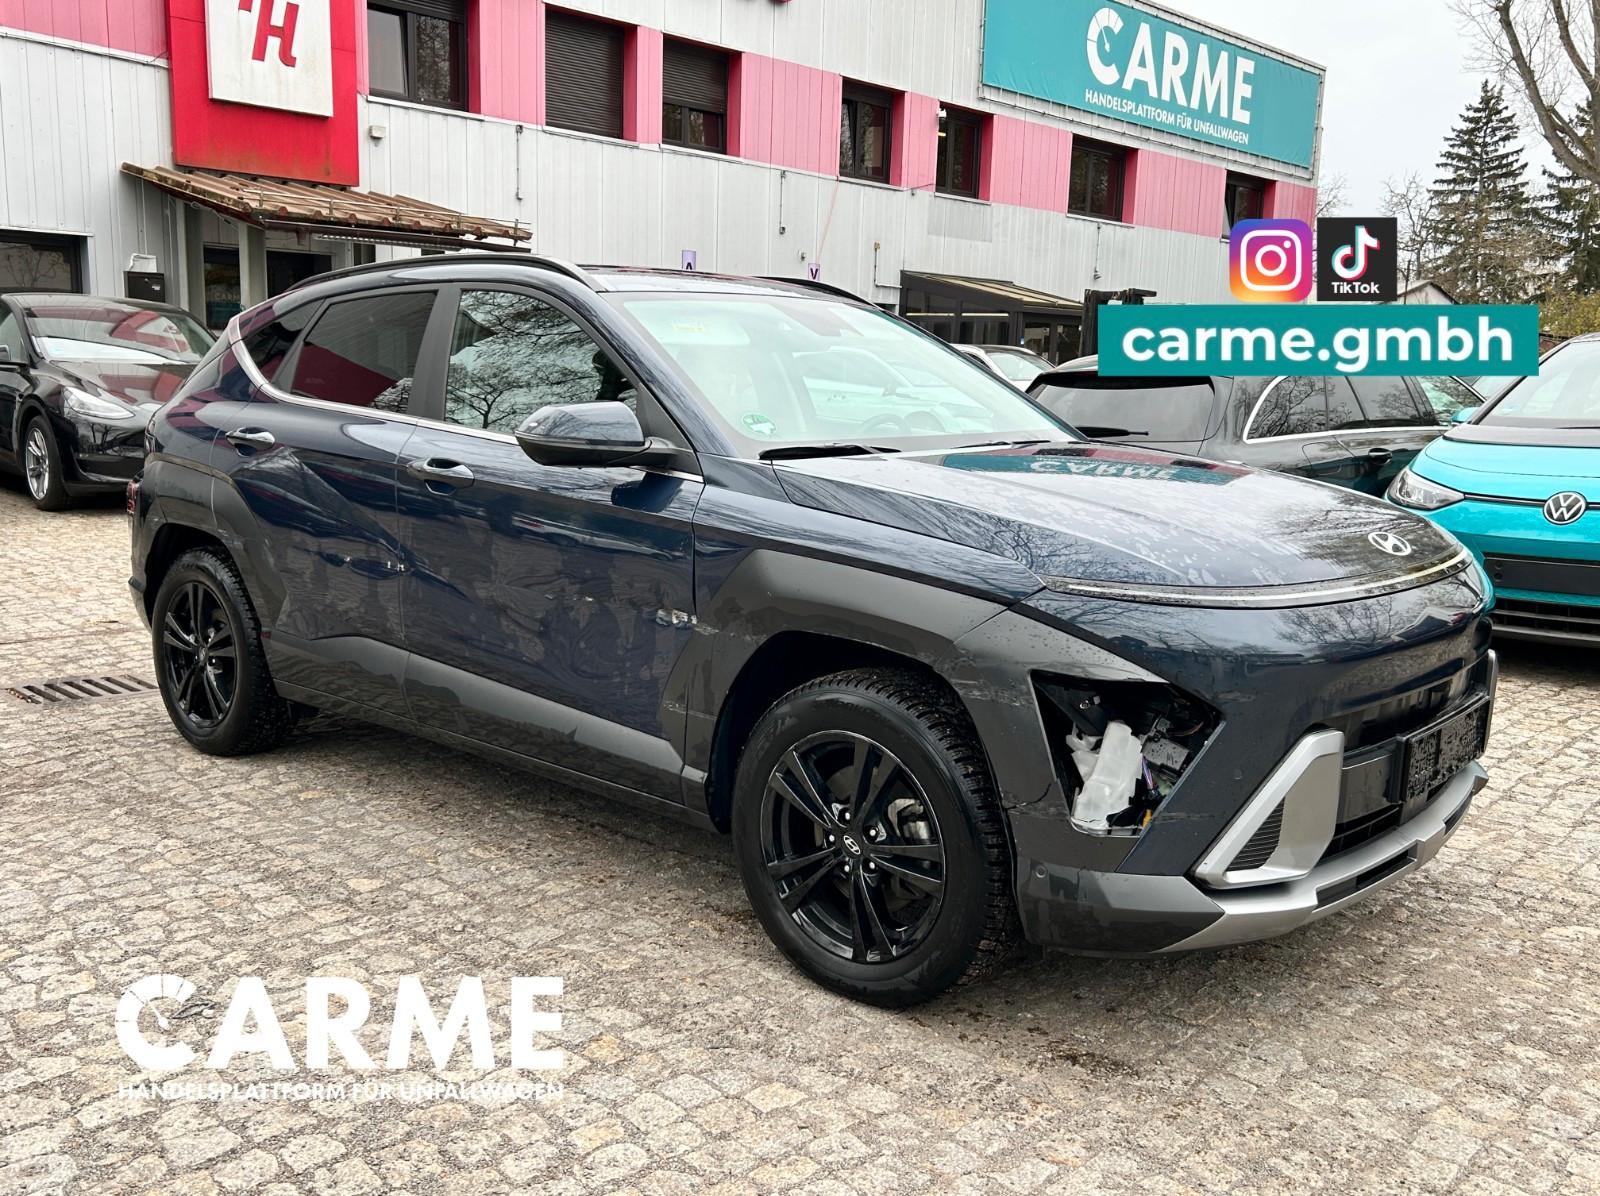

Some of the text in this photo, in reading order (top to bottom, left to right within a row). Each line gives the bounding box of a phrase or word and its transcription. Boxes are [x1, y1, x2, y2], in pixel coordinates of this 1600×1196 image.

[1086, 7, 1255, 125] CARME
[1085, 88, 1249, 145] HANDELSPLATTFORM FÜR UNFALLWAGEN
